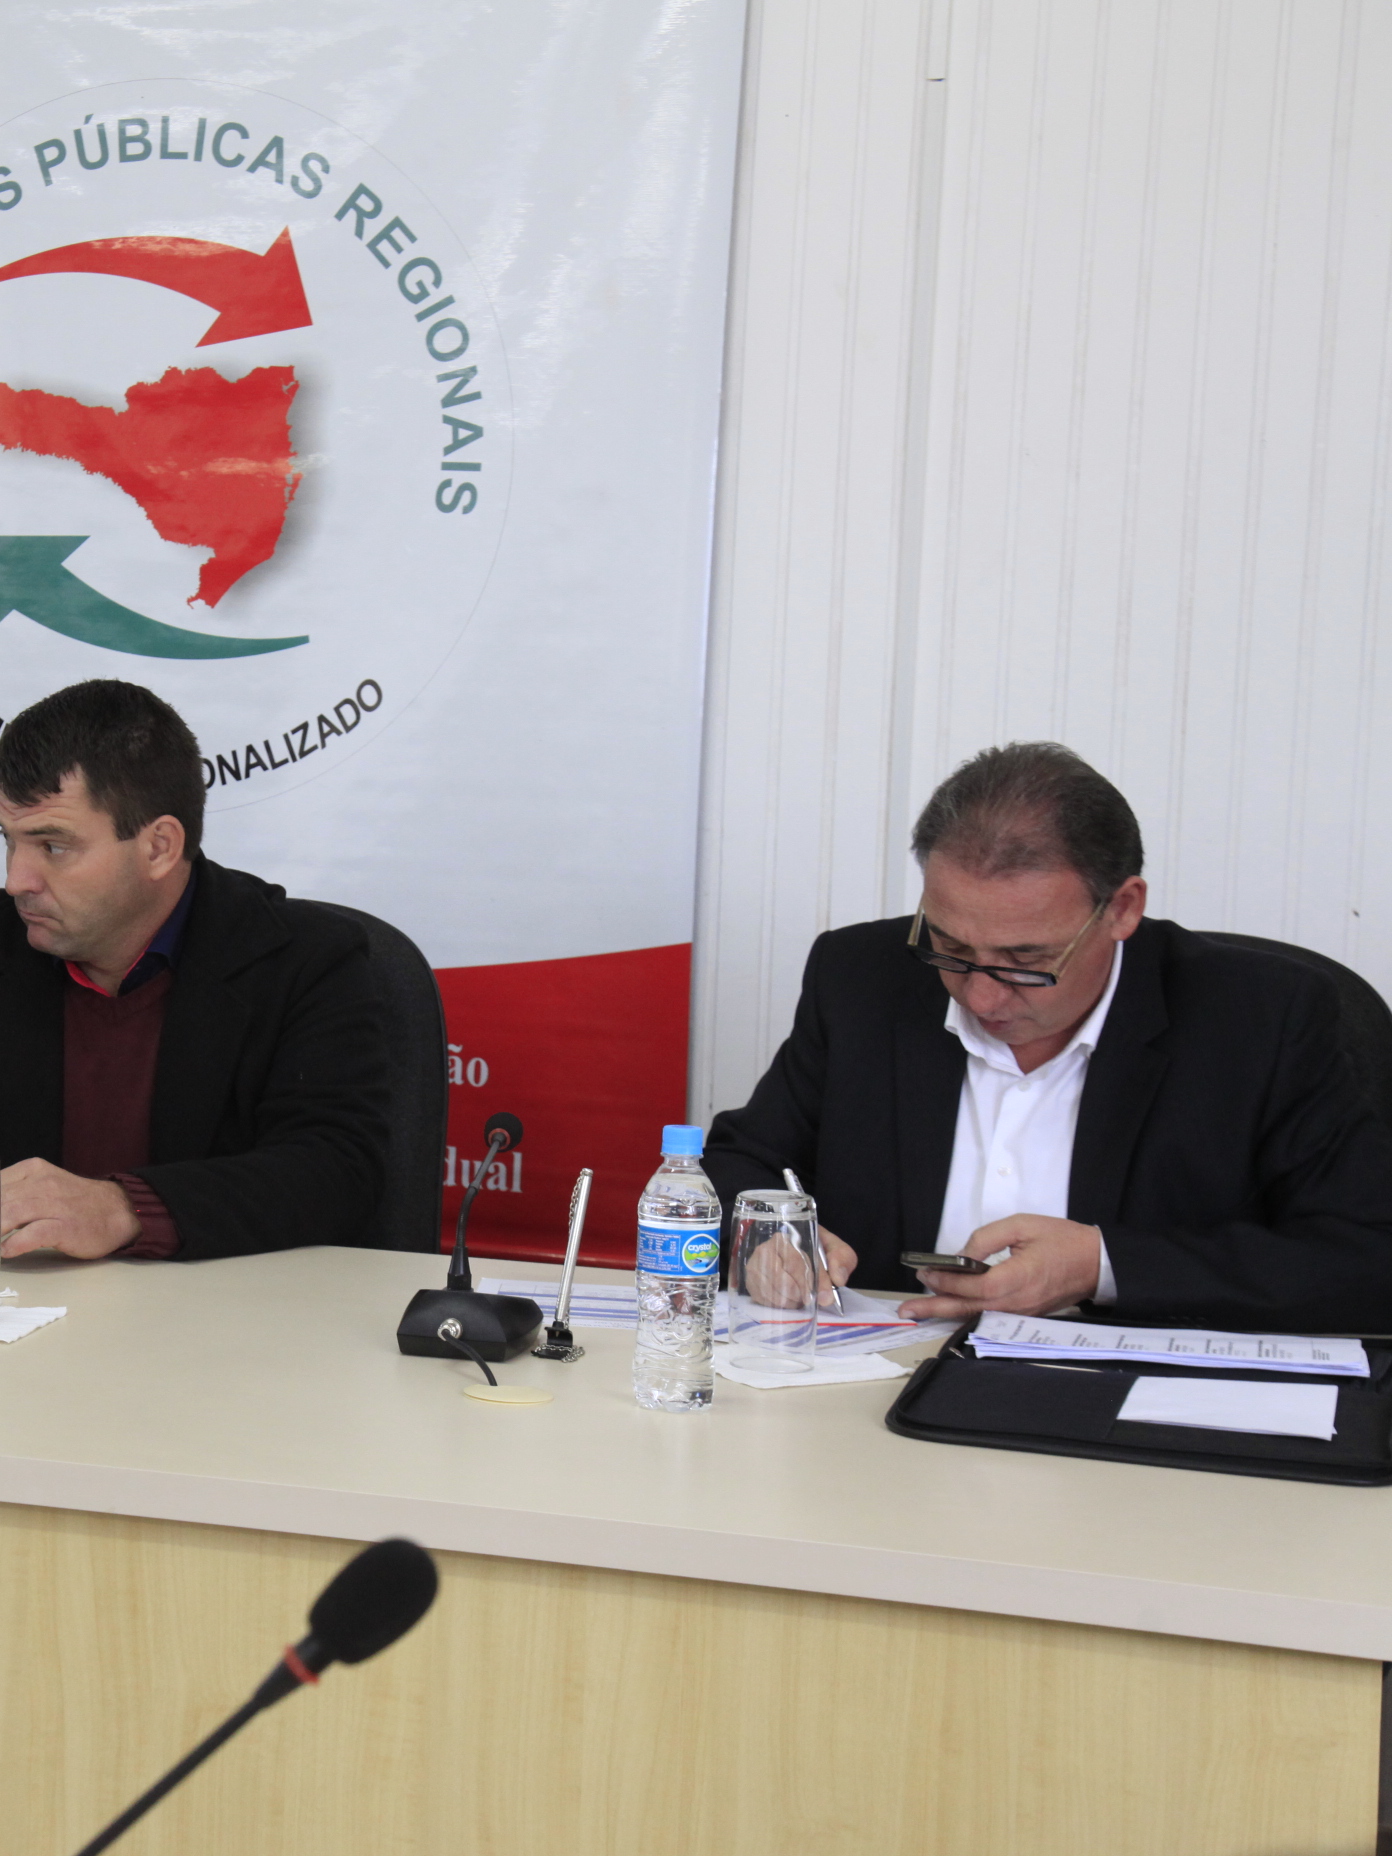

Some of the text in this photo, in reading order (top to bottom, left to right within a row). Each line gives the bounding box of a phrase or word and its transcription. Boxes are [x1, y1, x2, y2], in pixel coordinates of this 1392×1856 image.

[34, 113, 331, 199] PÚBLICAS
[334, 183, 484, 515] REGIONAIS
[447, 1043, 489, 1087] ão
[443, 1145, 523, 1193] dual
[687, 1243, 712, 1252] crystal
